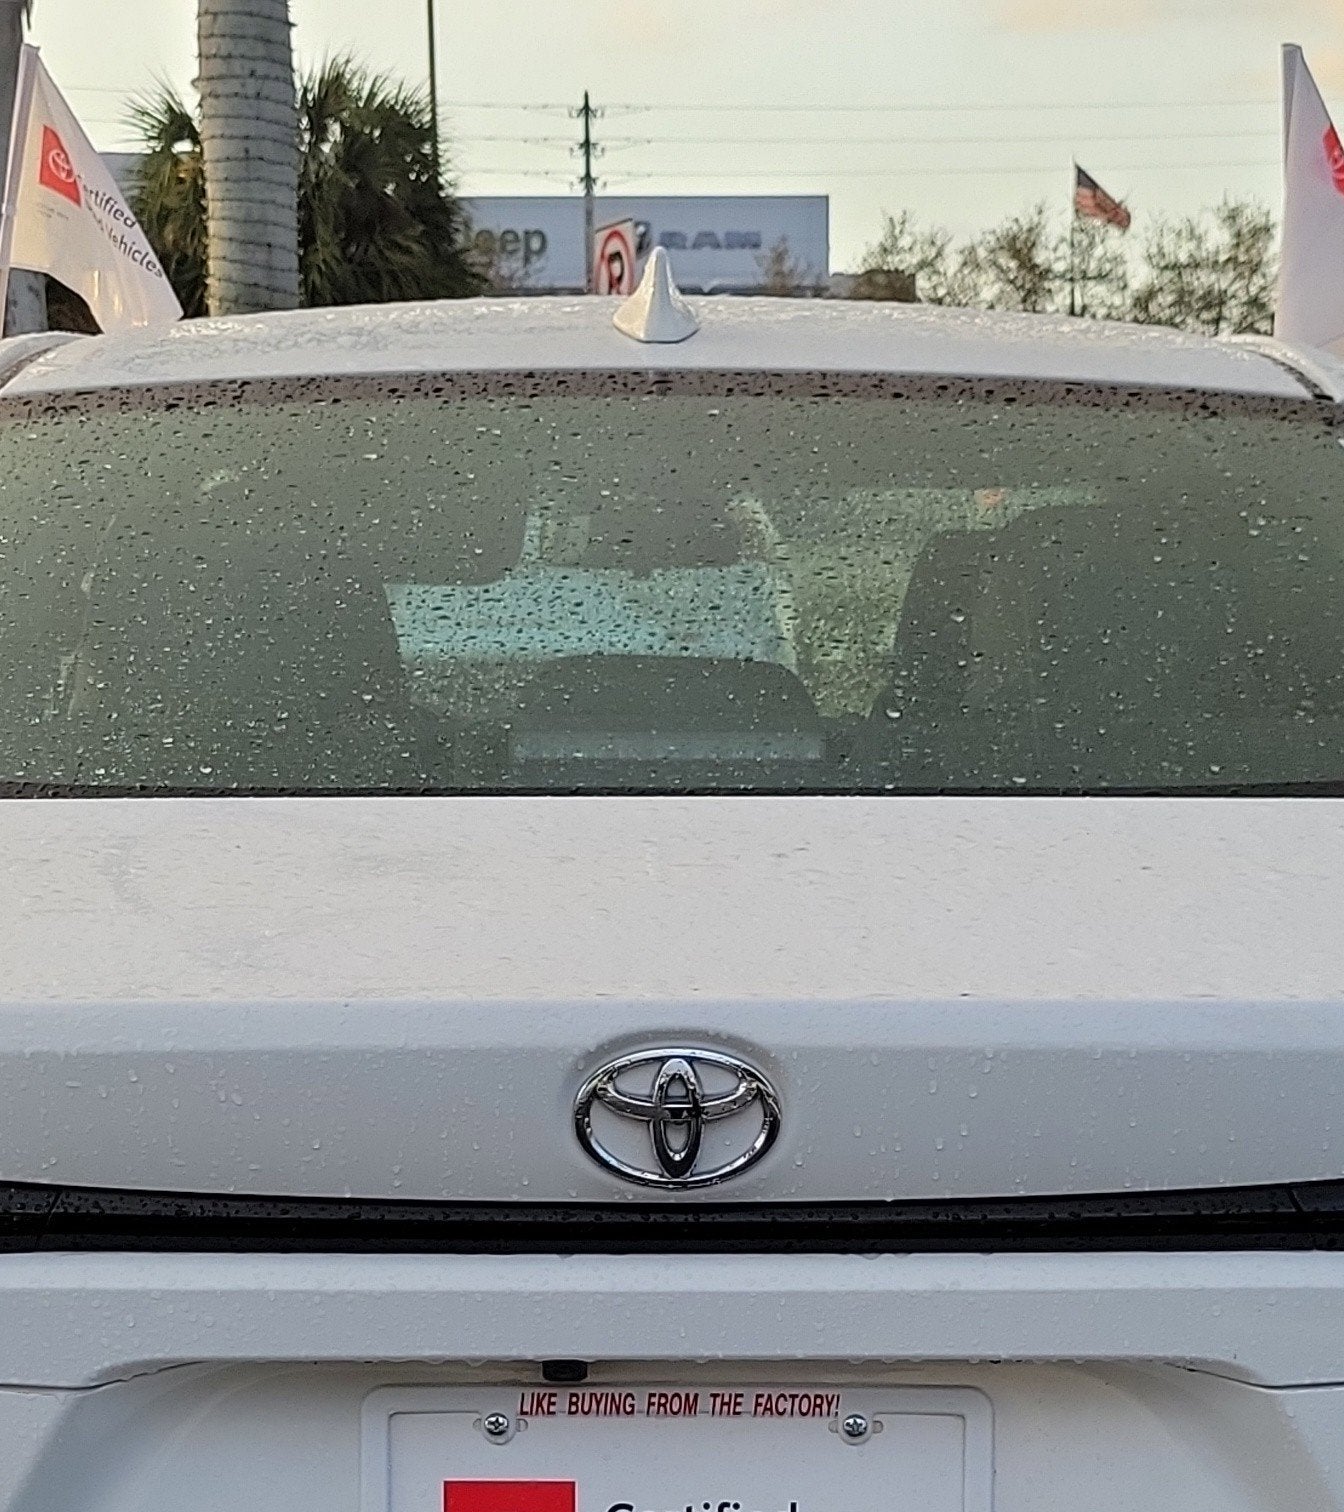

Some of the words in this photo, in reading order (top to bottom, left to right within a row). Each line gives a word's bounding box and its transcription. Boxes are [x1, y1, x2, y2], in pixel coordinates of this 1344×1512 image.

[76, 174, 137, 230] rtified
[659, 230, 762, 250] RAM
[519, 1392, 557, 1416] LIKE
[567, 1392, 636, 1416] BUYING
[646, 1392, 699, 1416] FROM
[709, 1392, 744, 1416] THE
[753, 1392, 841, 1417] FACTORY!
